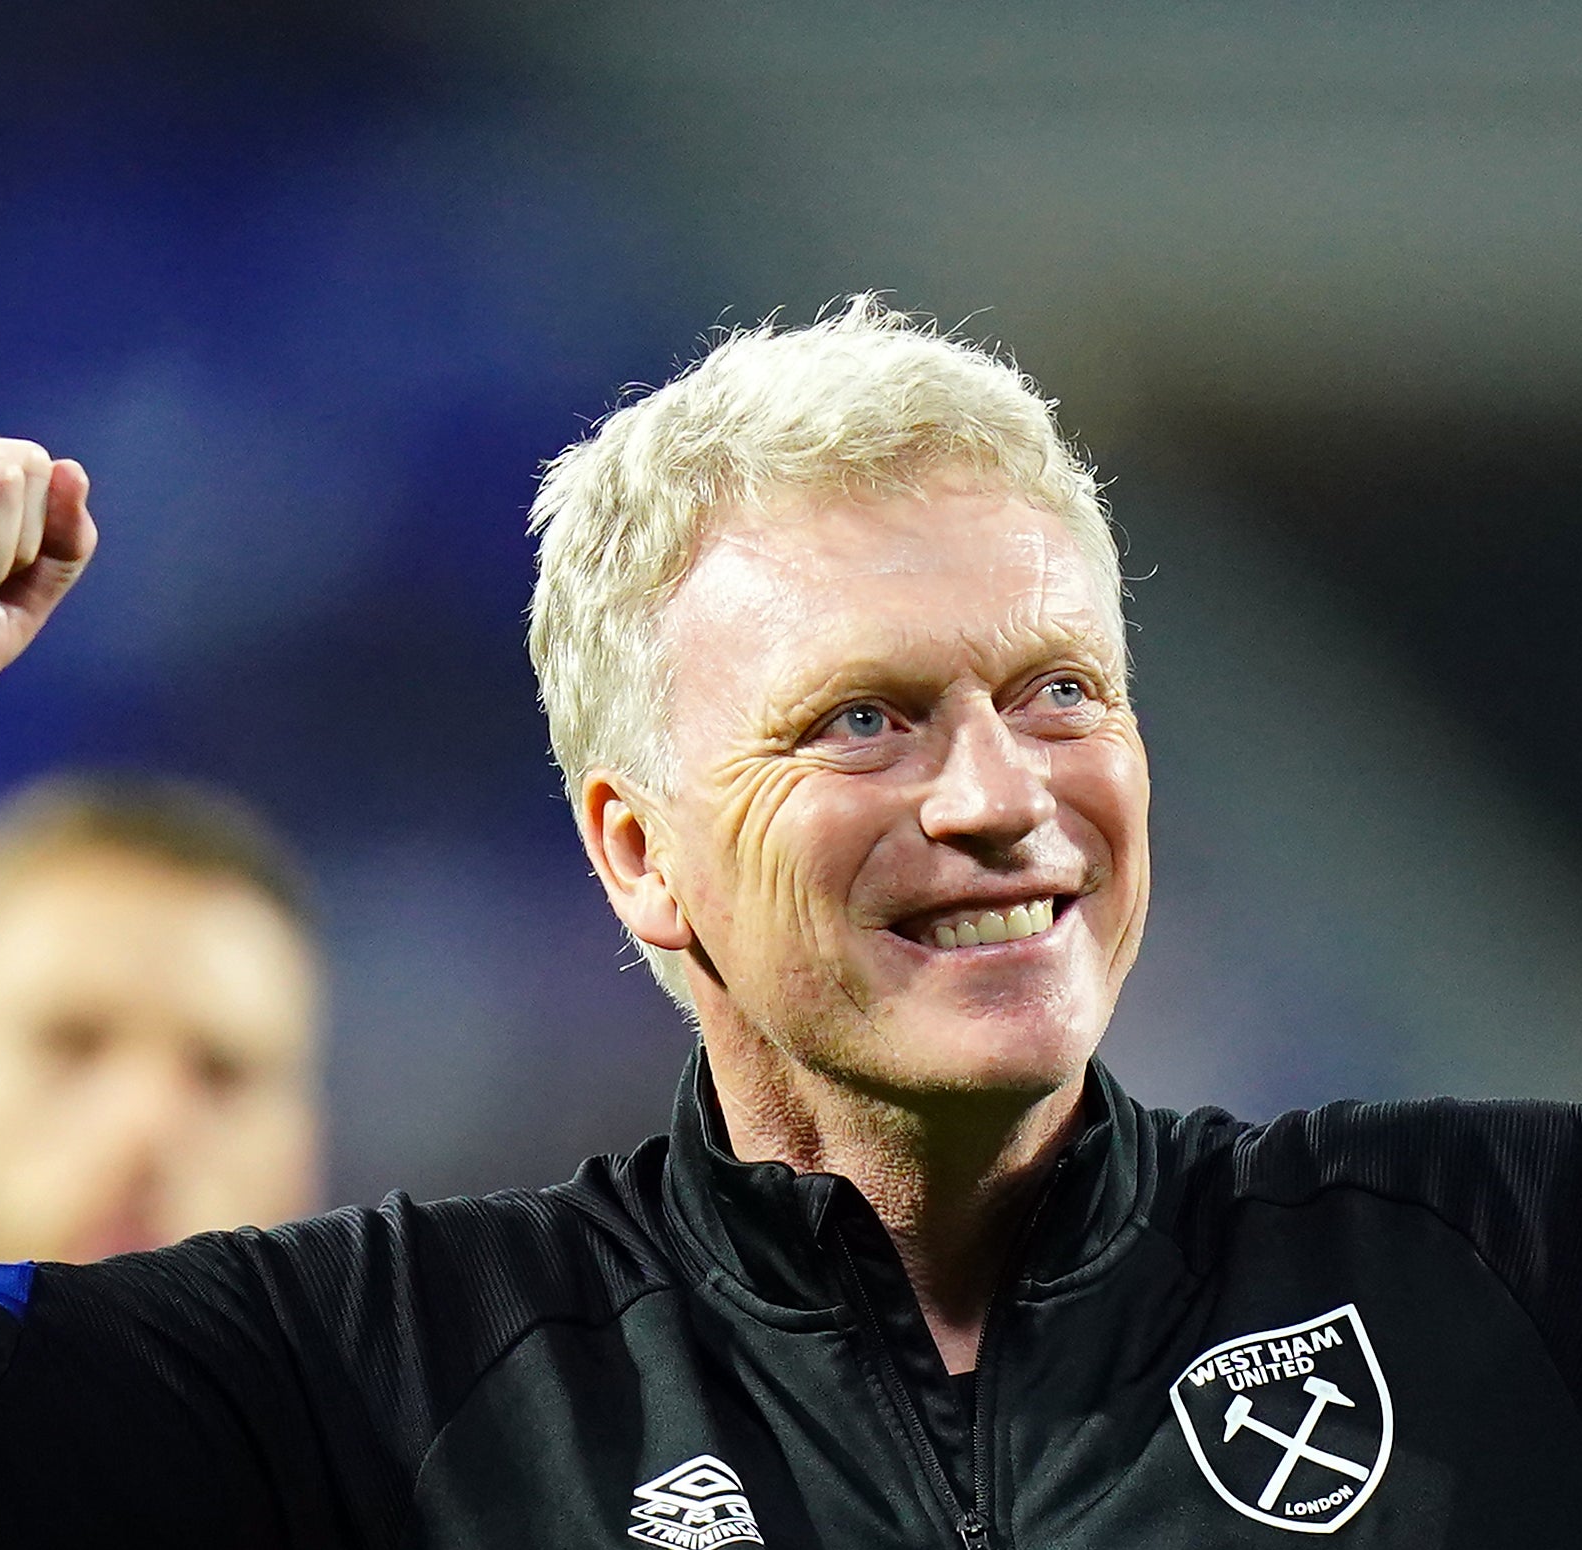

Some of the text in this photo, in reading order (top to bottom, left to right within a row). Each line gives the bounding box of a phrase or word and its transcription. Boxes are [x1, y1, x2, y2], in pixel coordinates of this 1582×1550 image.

[1187, 1325, 1343, 1387] WEST HAM
[1226, 1356, 1315, 1391] UNITED
[1284, 1484, 1354, 1516] LONDON
